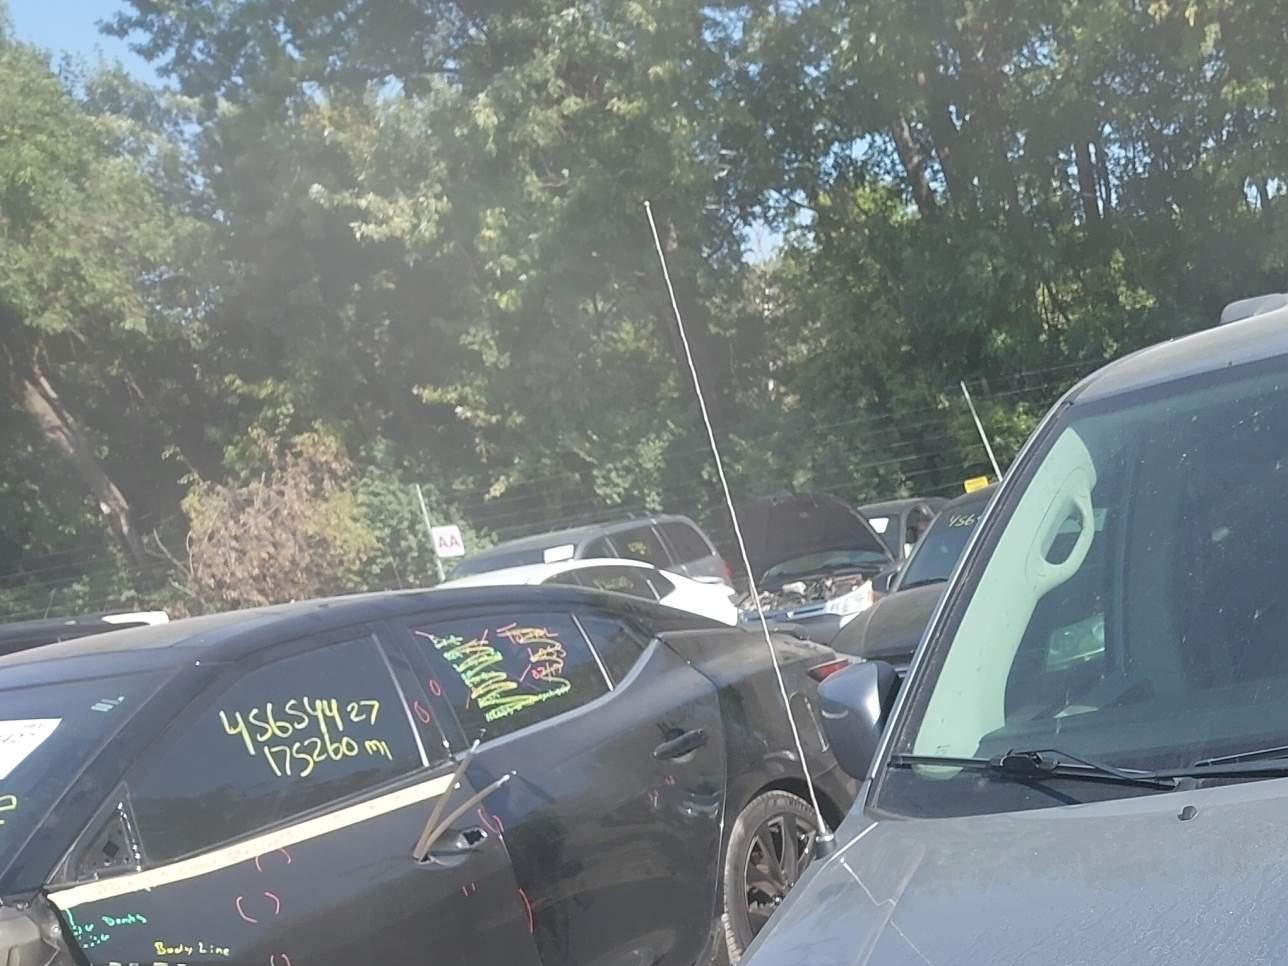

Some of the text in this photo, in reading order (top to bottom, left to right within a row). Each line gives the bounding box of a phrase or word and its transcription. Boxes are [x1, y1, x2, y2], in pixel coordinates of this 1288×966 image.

[218, 696, 380, 755] 45654427
[263, 736, 359, 777] 175260
[153, 941, 230, 957] Body Line
